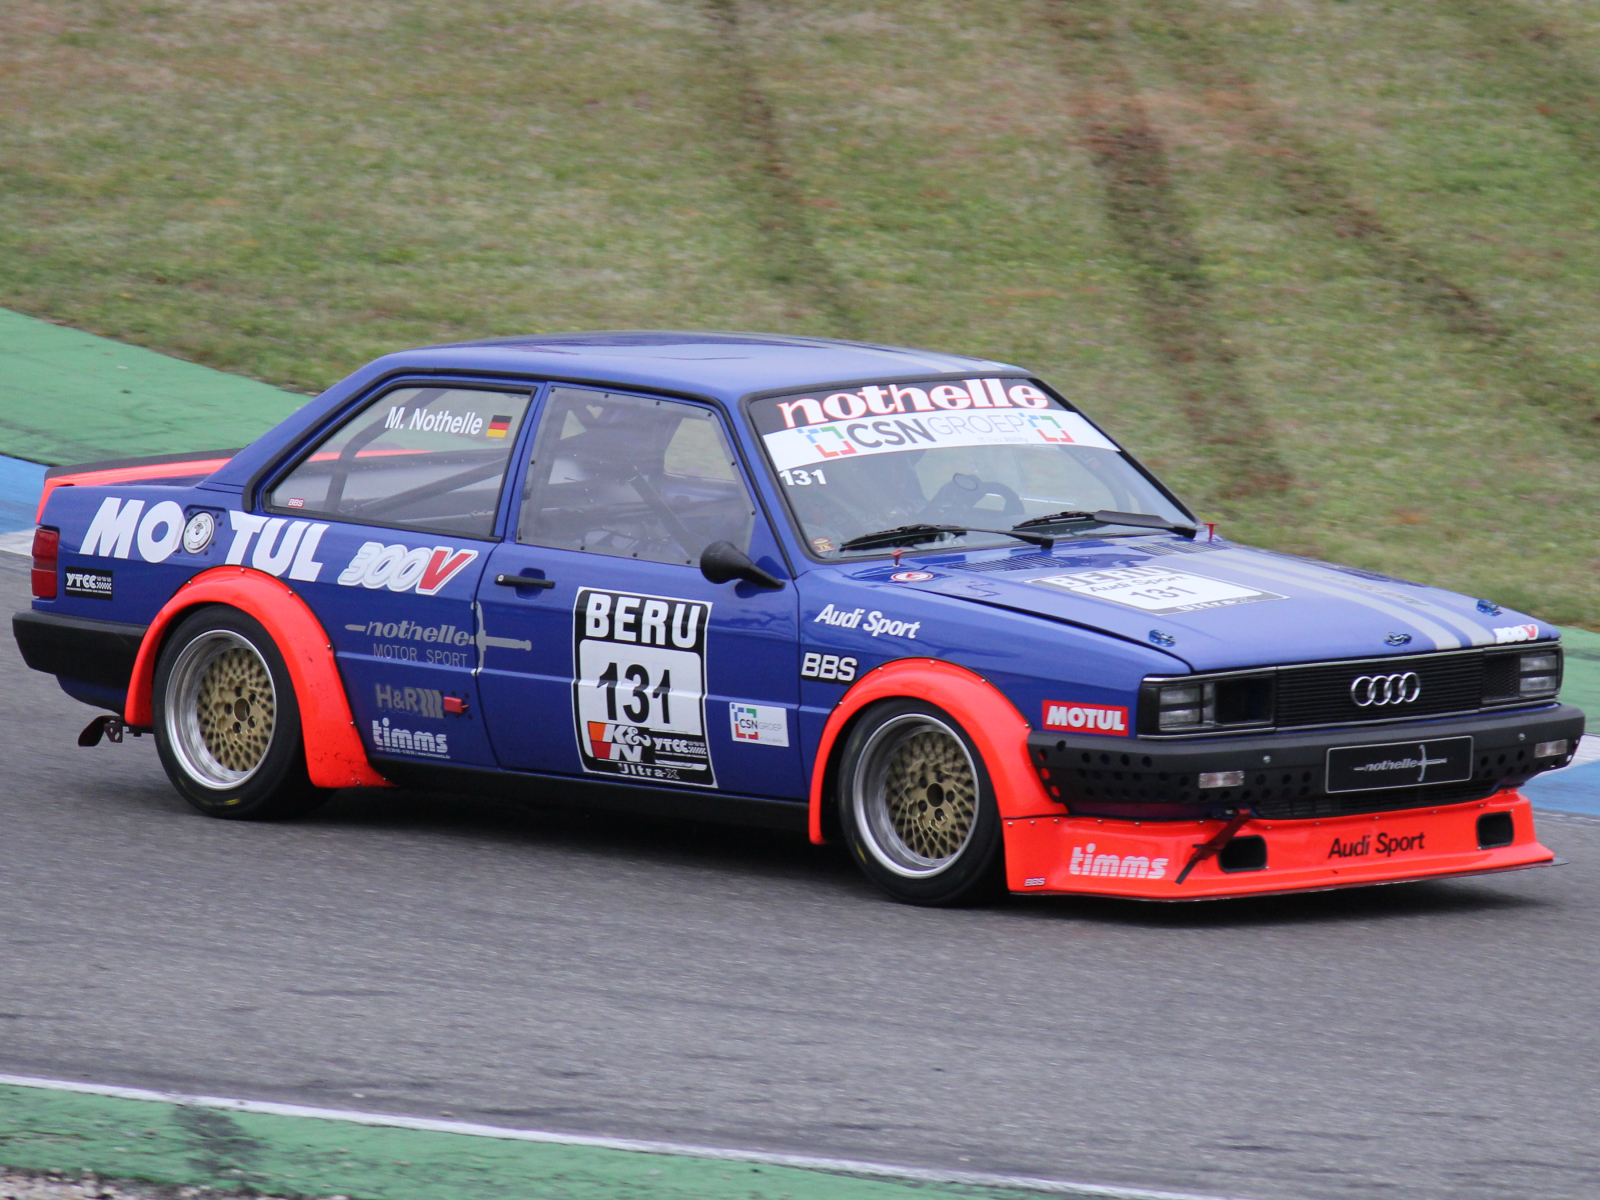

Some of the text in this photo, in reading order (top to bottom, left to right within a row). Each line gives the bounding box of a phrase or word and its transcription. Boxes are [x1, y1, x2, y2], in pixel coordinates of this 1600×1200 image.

[777, 379, 1049, 428] nothelle
[385, 406, 483, 435] M. Nothelle
[779, 468, 827, 486] 131
[288, 498, 304, 508] BBS
[66, 572, 97, 589] YTCC
[338, 541, 479, 596] 300V
[1129, 585, 1197, 601] 131
[367, 620, 470, 647] nothelle
[585, 592, 701, 649] BERU
[814, 603, 921, 639] Audi Sport
[373, 643, 468, 668] MOTOR SPORT
[801, 652, 858, 682] BBS
[374, 683, 419, 712] H&R
[597, 662, 671, 724] 131
[1046, 705, 1126, 731] MOTUL
[372, 717, 448, 754] timms
[652, 737, 689, 753] YTCC
[1364, 758, 1419, 772] nothelle
[1328, 831, 1425, 860] Audi Sport
[1069, 842, 1169, 879] timms
[1024, 877, 1046, 887] BBS
